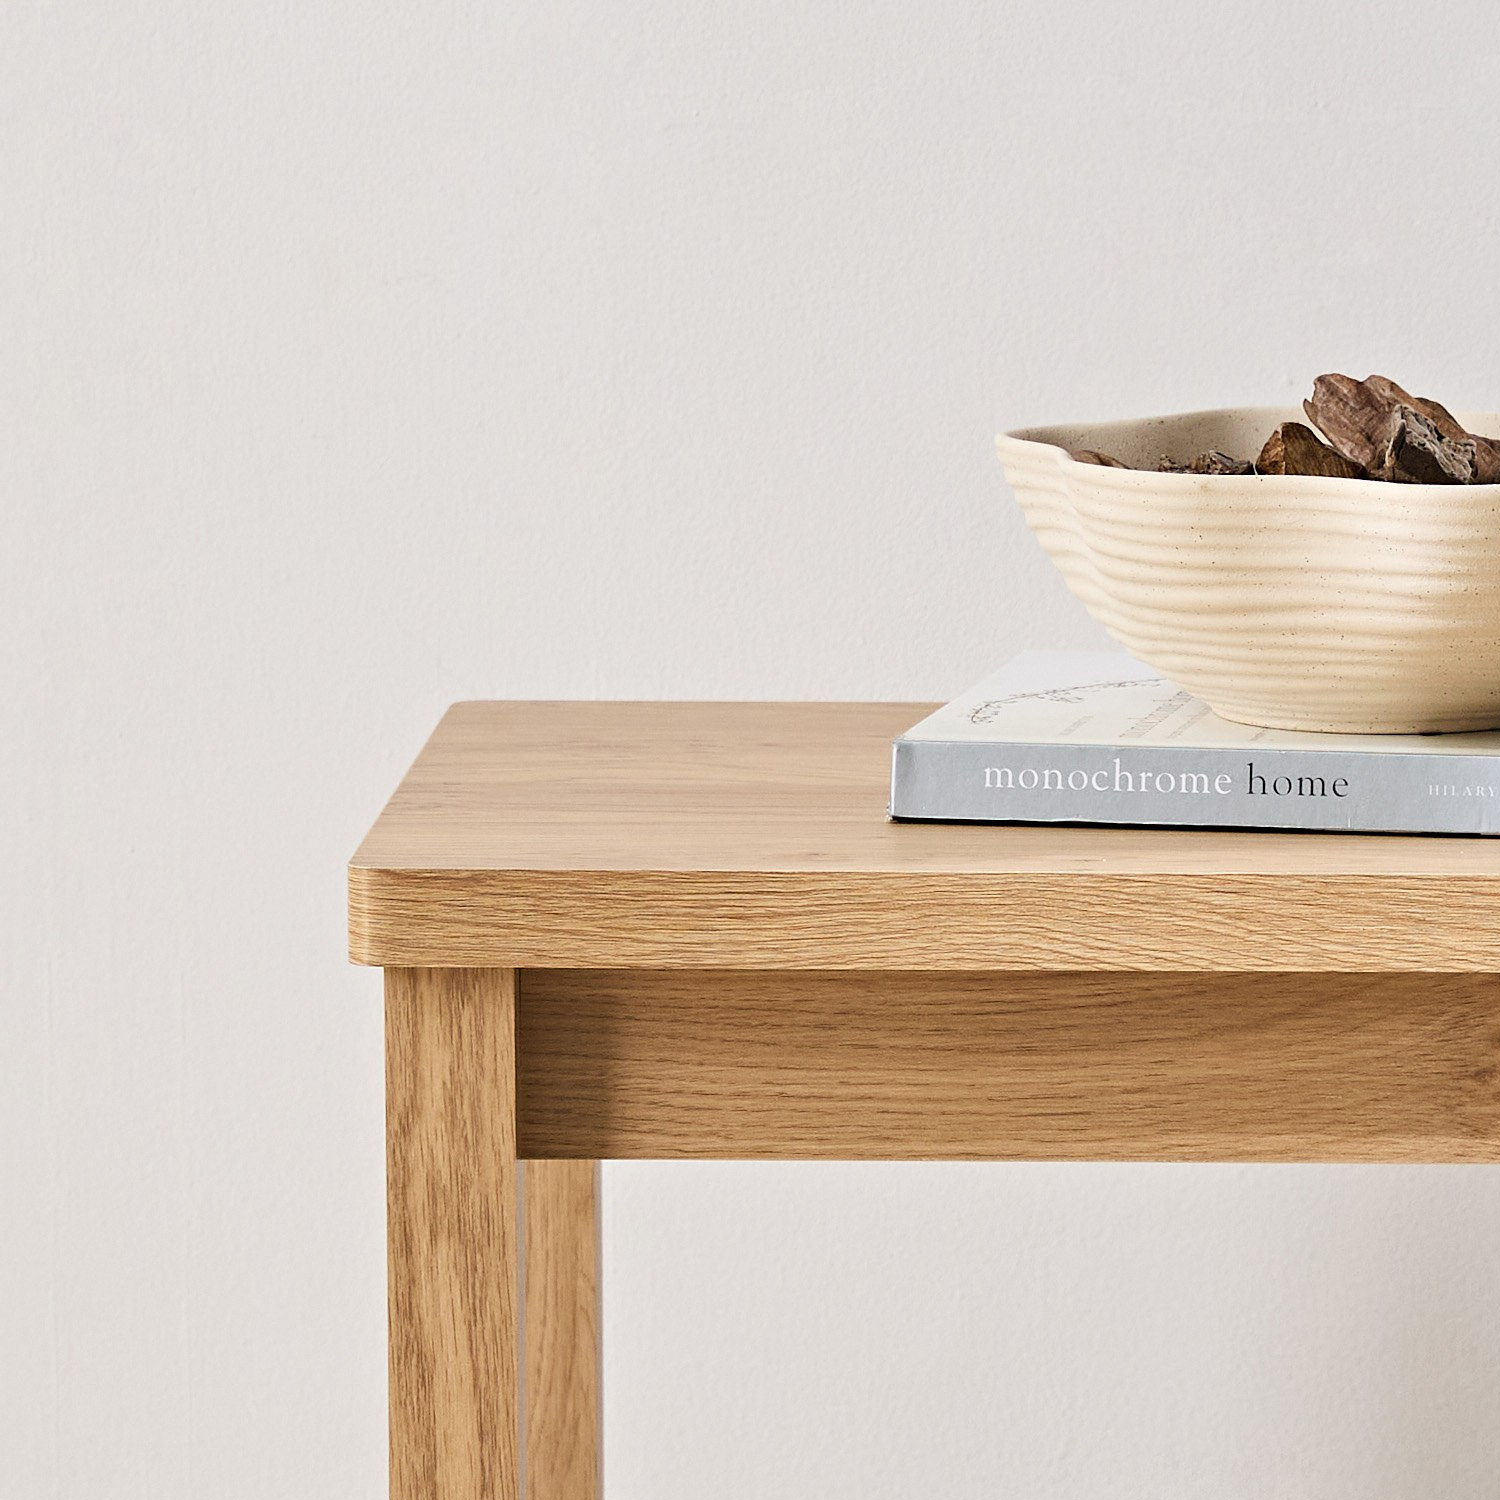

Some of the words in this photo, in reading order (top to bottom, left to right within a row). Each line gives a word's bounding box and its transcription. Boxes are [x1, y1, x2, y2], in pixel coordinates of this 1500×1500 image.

[984, 757, 1232, 795] monochrome
[1246, 761, 1349, 798] home
[1429, 784, 1498, 798] HILARY
